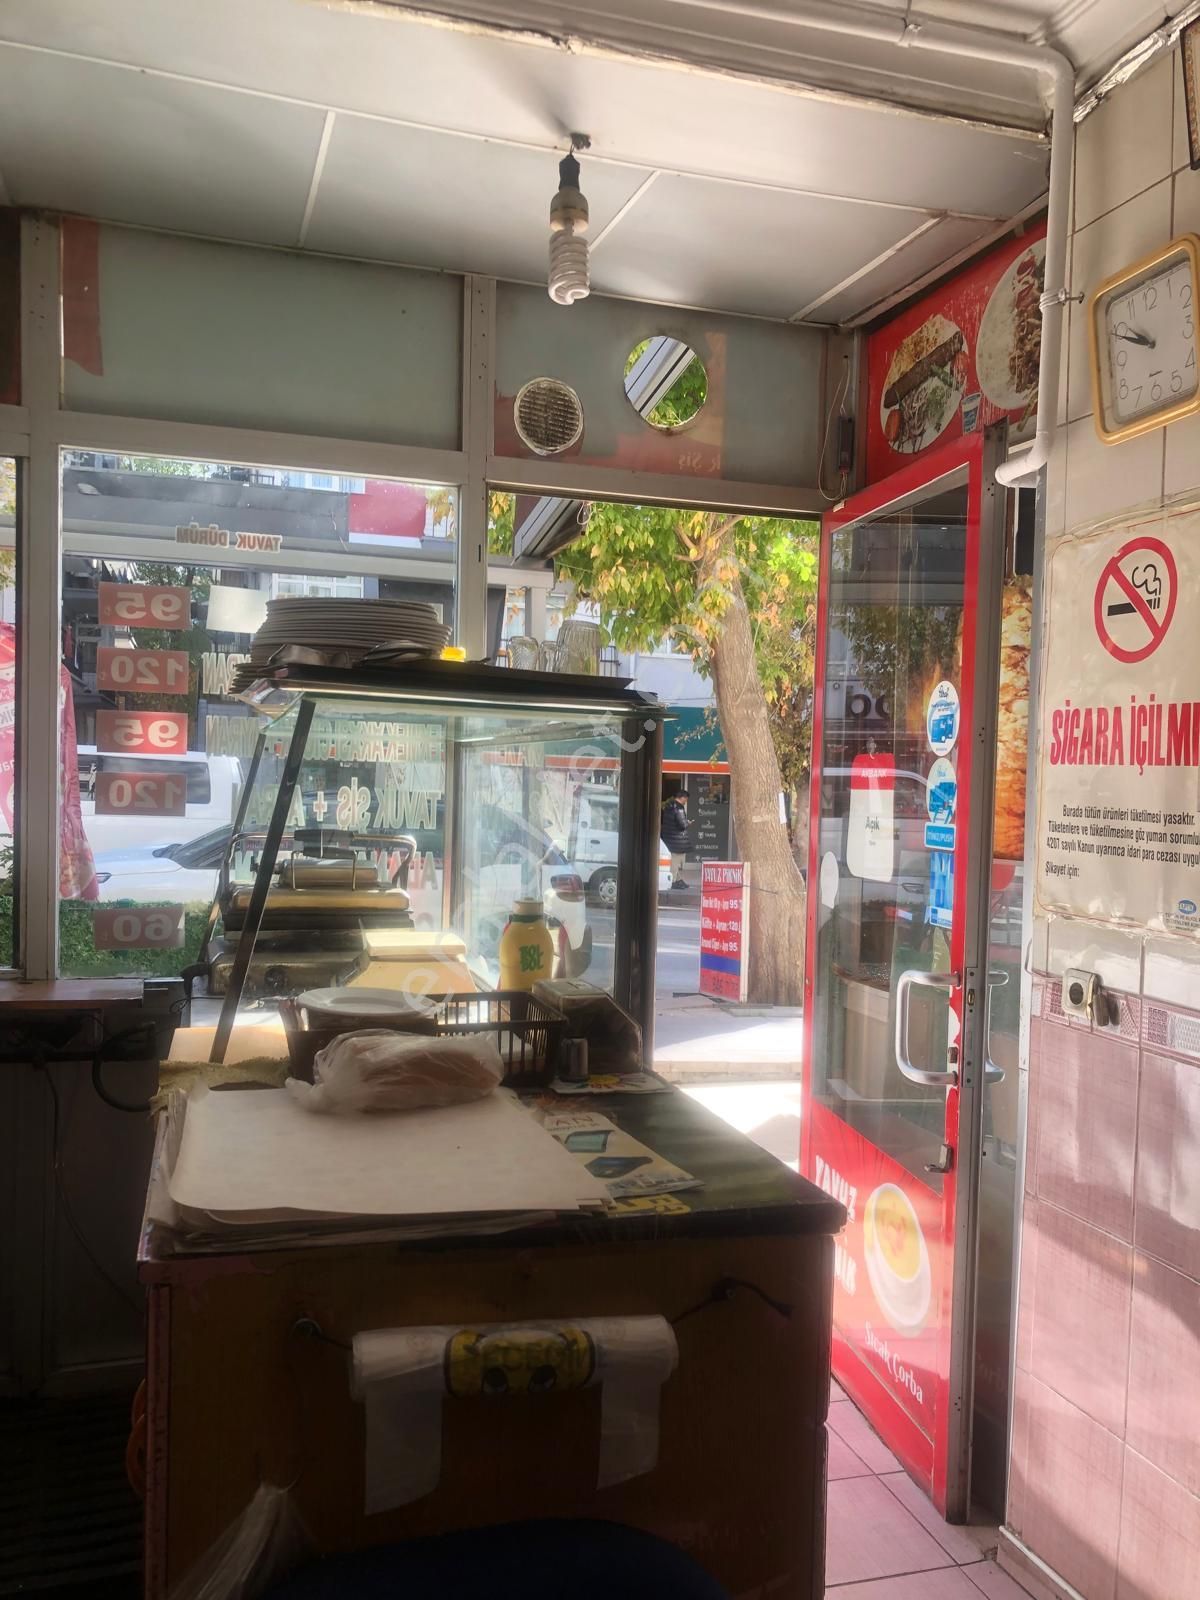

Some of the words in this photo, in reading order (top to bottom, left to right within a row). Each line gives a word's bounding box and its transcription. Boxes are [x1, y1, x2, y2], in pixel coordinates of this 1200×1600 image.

[1127, 297, 1136, 321] 11
[1143, 286, 1158, 312] 12
[1180, 285, 1192, 309] 2
[1182, 314, 1195, 340] 3
[1117, 350, 1127, 371] 9
[1184, 346, 1196, 369] 4
[1119, 378, 1129, 400] 8
[1150, 379, 1162, 401] 6
[1170, 369, 1182, 393] 5
[1131, 385, 1143, 409] 7
[1050, 699, 1124, 766] SİGARA
[861, 768, 887, 778] AKBANK
[865, 816, 880, 832] Açık
[1063, 804, 1083, 817] Burada
[1084, 806, 1101, 820] tütün
[1102, 807, 1129, 821] ürünleri
[1130, 809, 1162, 824] tüketilmesi
[1163, 811, 1196, 827] yasaktır.
[1048, 820, 1080, 835] Tüketenlere
[1081, 825, 1089, 836] ve
[1089, 823, 1134, 840] tüketilmesine
[1135, 828, 1145, 843] göz
[1146, 831, 1168, 844] yuman
[1077, 840, 1095, 854] Kanun
[1095, 844, 1126, 859] uyarınca
[1126, 844, 1141, 860] idari
[1141, 847, 1155, 862] para
[1156, 850, 1181, 864] cezası
[1045, 860, 1066, 877] Şikayet
[1066, 863, 1080, 879] için:
[865, 1319, 893, 1375] Sıcak
[893, 1352, 923, 1405] Çorba
